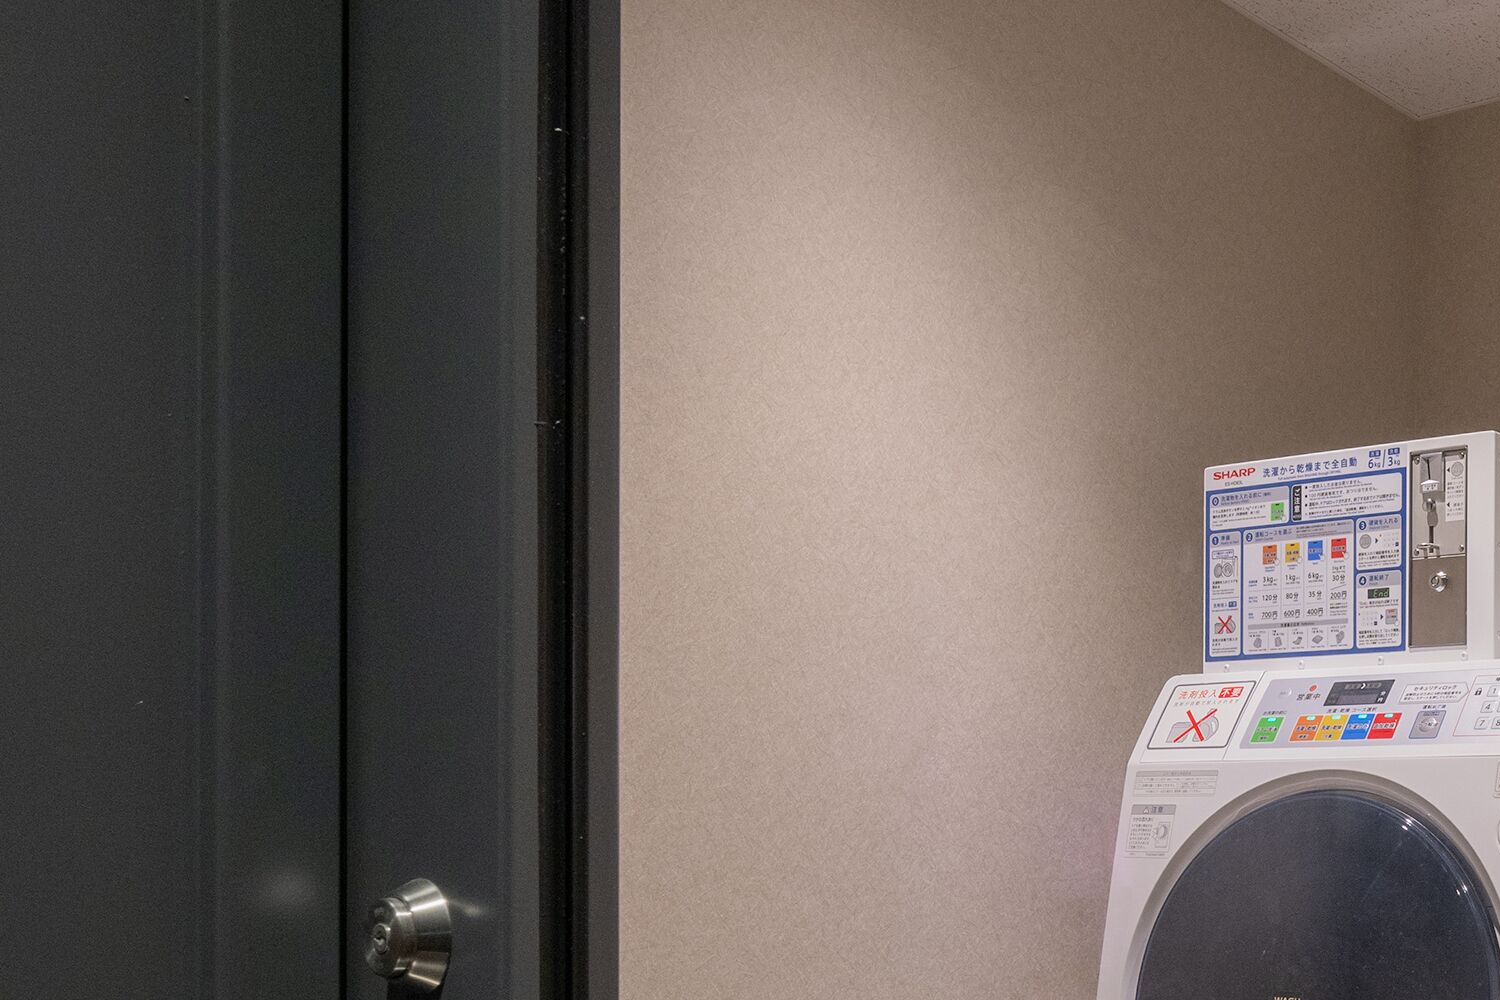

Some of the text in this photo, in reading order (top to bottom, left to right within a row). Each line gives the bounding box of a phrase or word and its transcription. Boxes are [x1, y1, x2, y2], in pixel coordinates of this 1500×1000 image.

[1368, 459, 1381, 469] 6kg
[1388, 456, 1400, 467] 3kg
[1263, 457, 1358, 478] 洗濯から乾燥まで全自動
[1213, 467, 1256, 481] SHARP
[1262, 594, 1278, 602] 120分
[1330, 591, 1347, 600] 200円
[1373, 589, 1389, 598] End
[1261, 610, 1278, 618] 700円
[1284, 609, 1300, 617] 600円
[1307, 607, 1324, 616] 400円
[1179, 687, 1242, 700] 洗剤投入 不要
[1296, 693, 1321, 701] 営業中
[1485, 703, 1491, 711] 4
[1480, 719, 1485, 727] 7
